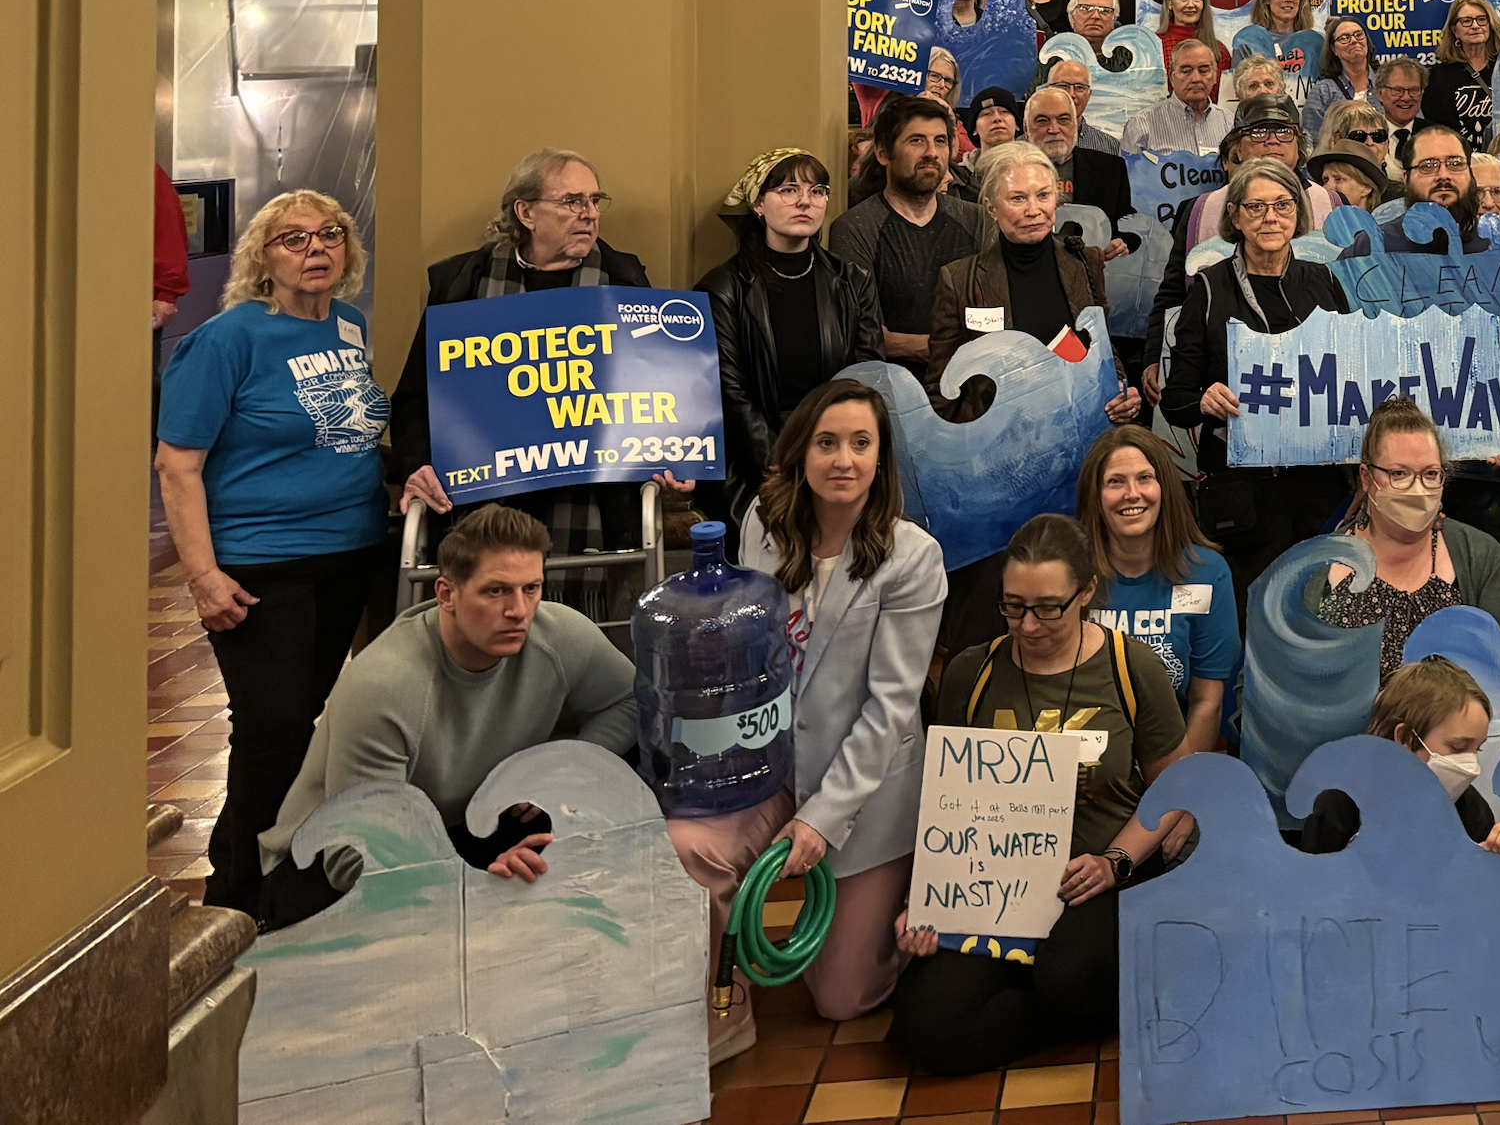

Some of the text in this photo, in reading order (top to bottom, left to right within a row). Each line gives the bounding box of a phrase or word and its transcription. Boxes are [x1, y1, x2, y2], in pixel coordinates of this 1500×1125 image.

[911, 0, 931, 7] WATCH
[847, 7, 897, 35] TORY
[1366, 13, 1406, 30] OUR
[853, 30, 918, 62] FARMS
[1383, 29, 1444, 48] WATER
[867, 67, 878, 76] TO
[878, 63, 922, 86] 23321
[620, 313, 701, 325] WATER WATCH
[439, 324, 617, 372] PROTECT
[287, 350, 342, 381] IOWA
[507, 359, 596, 397] OUR
[296, 377, 320, 389] FOR
[546, 391, 679, 429] WATER
[446, 464, 492, 487] TEXT
[495, 439, 589, 478] FWW
[594, 449, 619, 464] TO
[621, 435, 715, 463] 23321
[1088, 609, 1172, 635] OWA CCI
[737, 702, 780, 740] $500
[940, 734, 1054, 785] MRSA
[939, 795, 962, 811] Got
[971, 799, 980, 813] it
[989, 802, 1000, 812] at
[1048, 806, 1069, 818] park
[987, 815, 1005, 823] 2025
[924, 826, 1058, 859] OUR WATER
[969, 856, 985, 874] is
